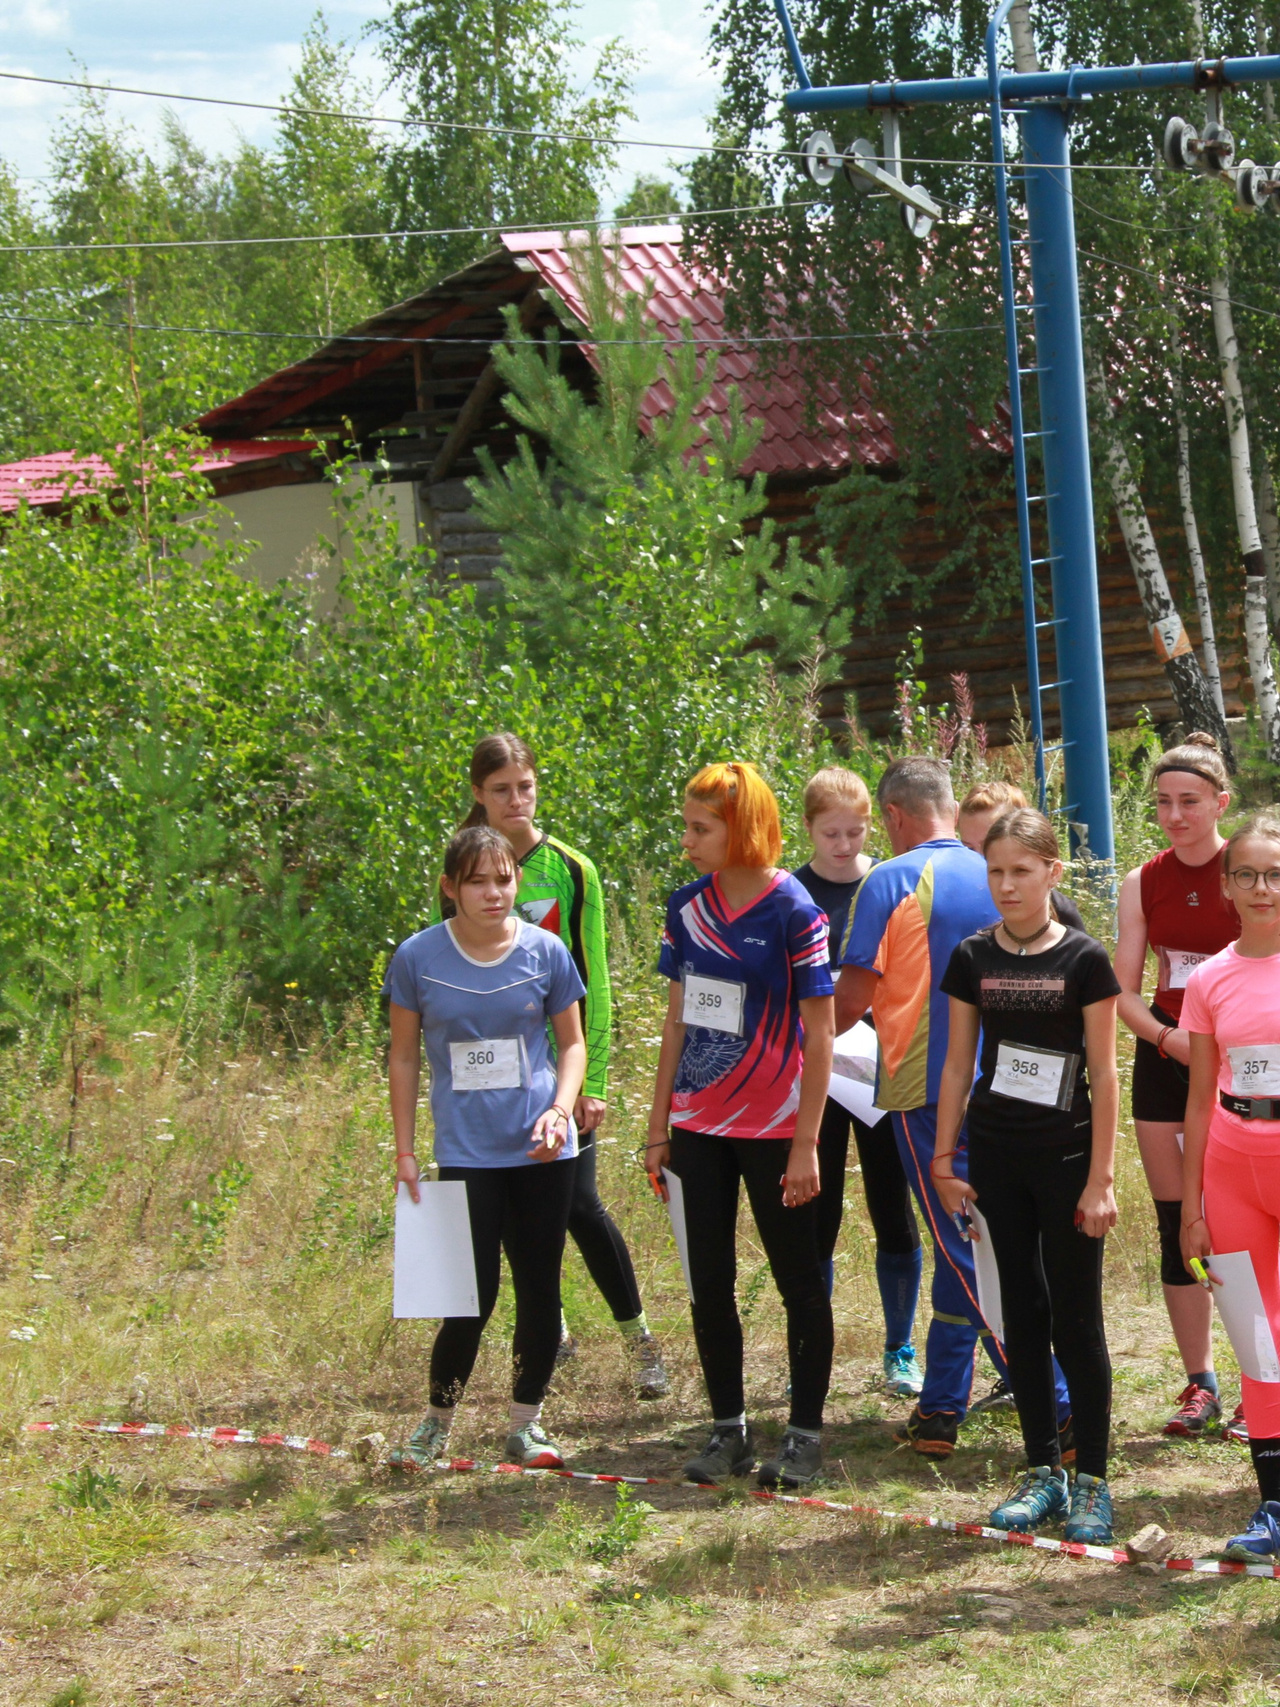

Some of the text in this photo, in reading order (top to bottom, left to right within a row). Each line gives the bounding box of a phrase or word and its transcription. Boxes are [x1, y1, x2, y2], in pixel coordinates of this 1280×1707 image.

[1164, 630, 1175, 646] 5
[698, 991, 722, 1008] 359
[467, 1051, 495, 1065] 360
[1012, 1058, 1039, 1077] 358
[1243, 1060, 1269, 1075] 357
